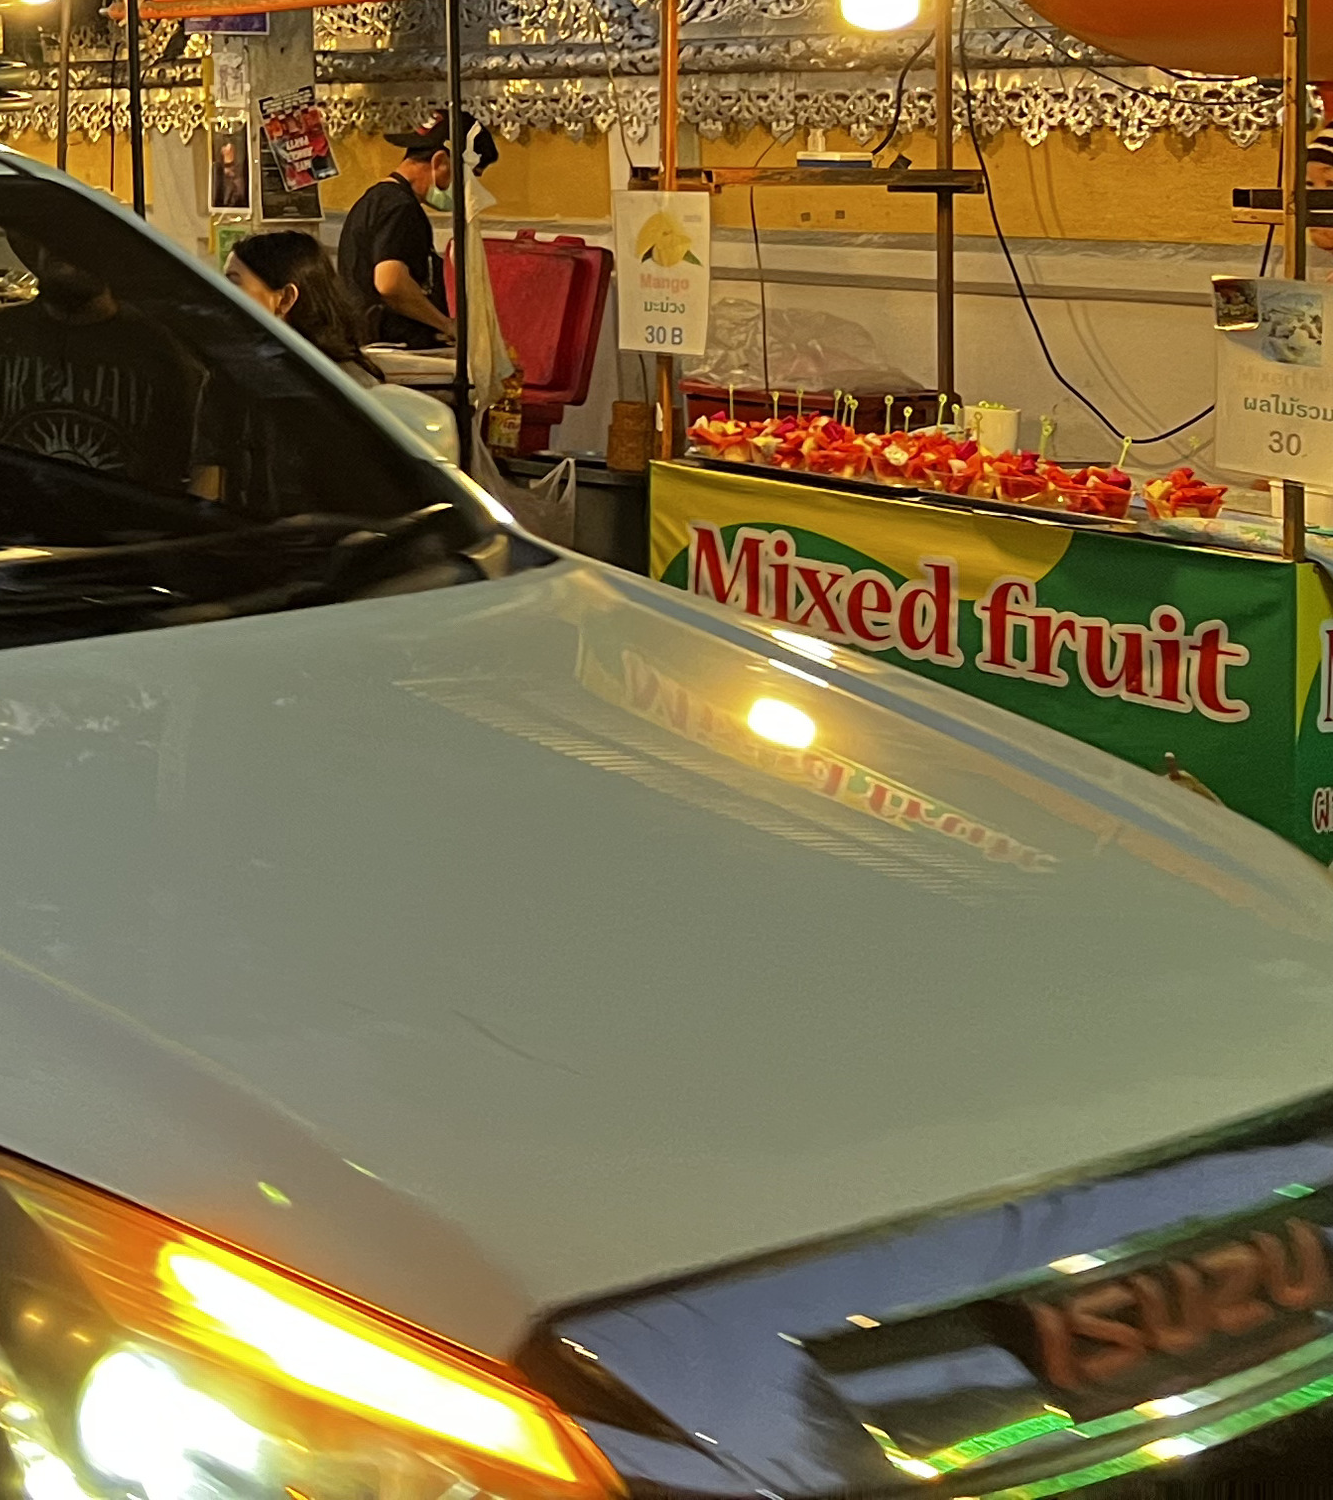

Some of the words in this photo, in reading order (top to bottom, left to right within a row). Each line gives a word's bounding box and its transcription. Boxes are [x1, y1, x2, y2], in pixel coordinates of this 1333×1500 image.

[640, 273, 690, 293] Mango
[644, 296, 686, 314] มะม่วง
[645, 325, 667, 344] 30
[671, 327, 683, 345] B
[693, 526, 955, 658] Mixed
[981, 581, 1243, 714] fruit
